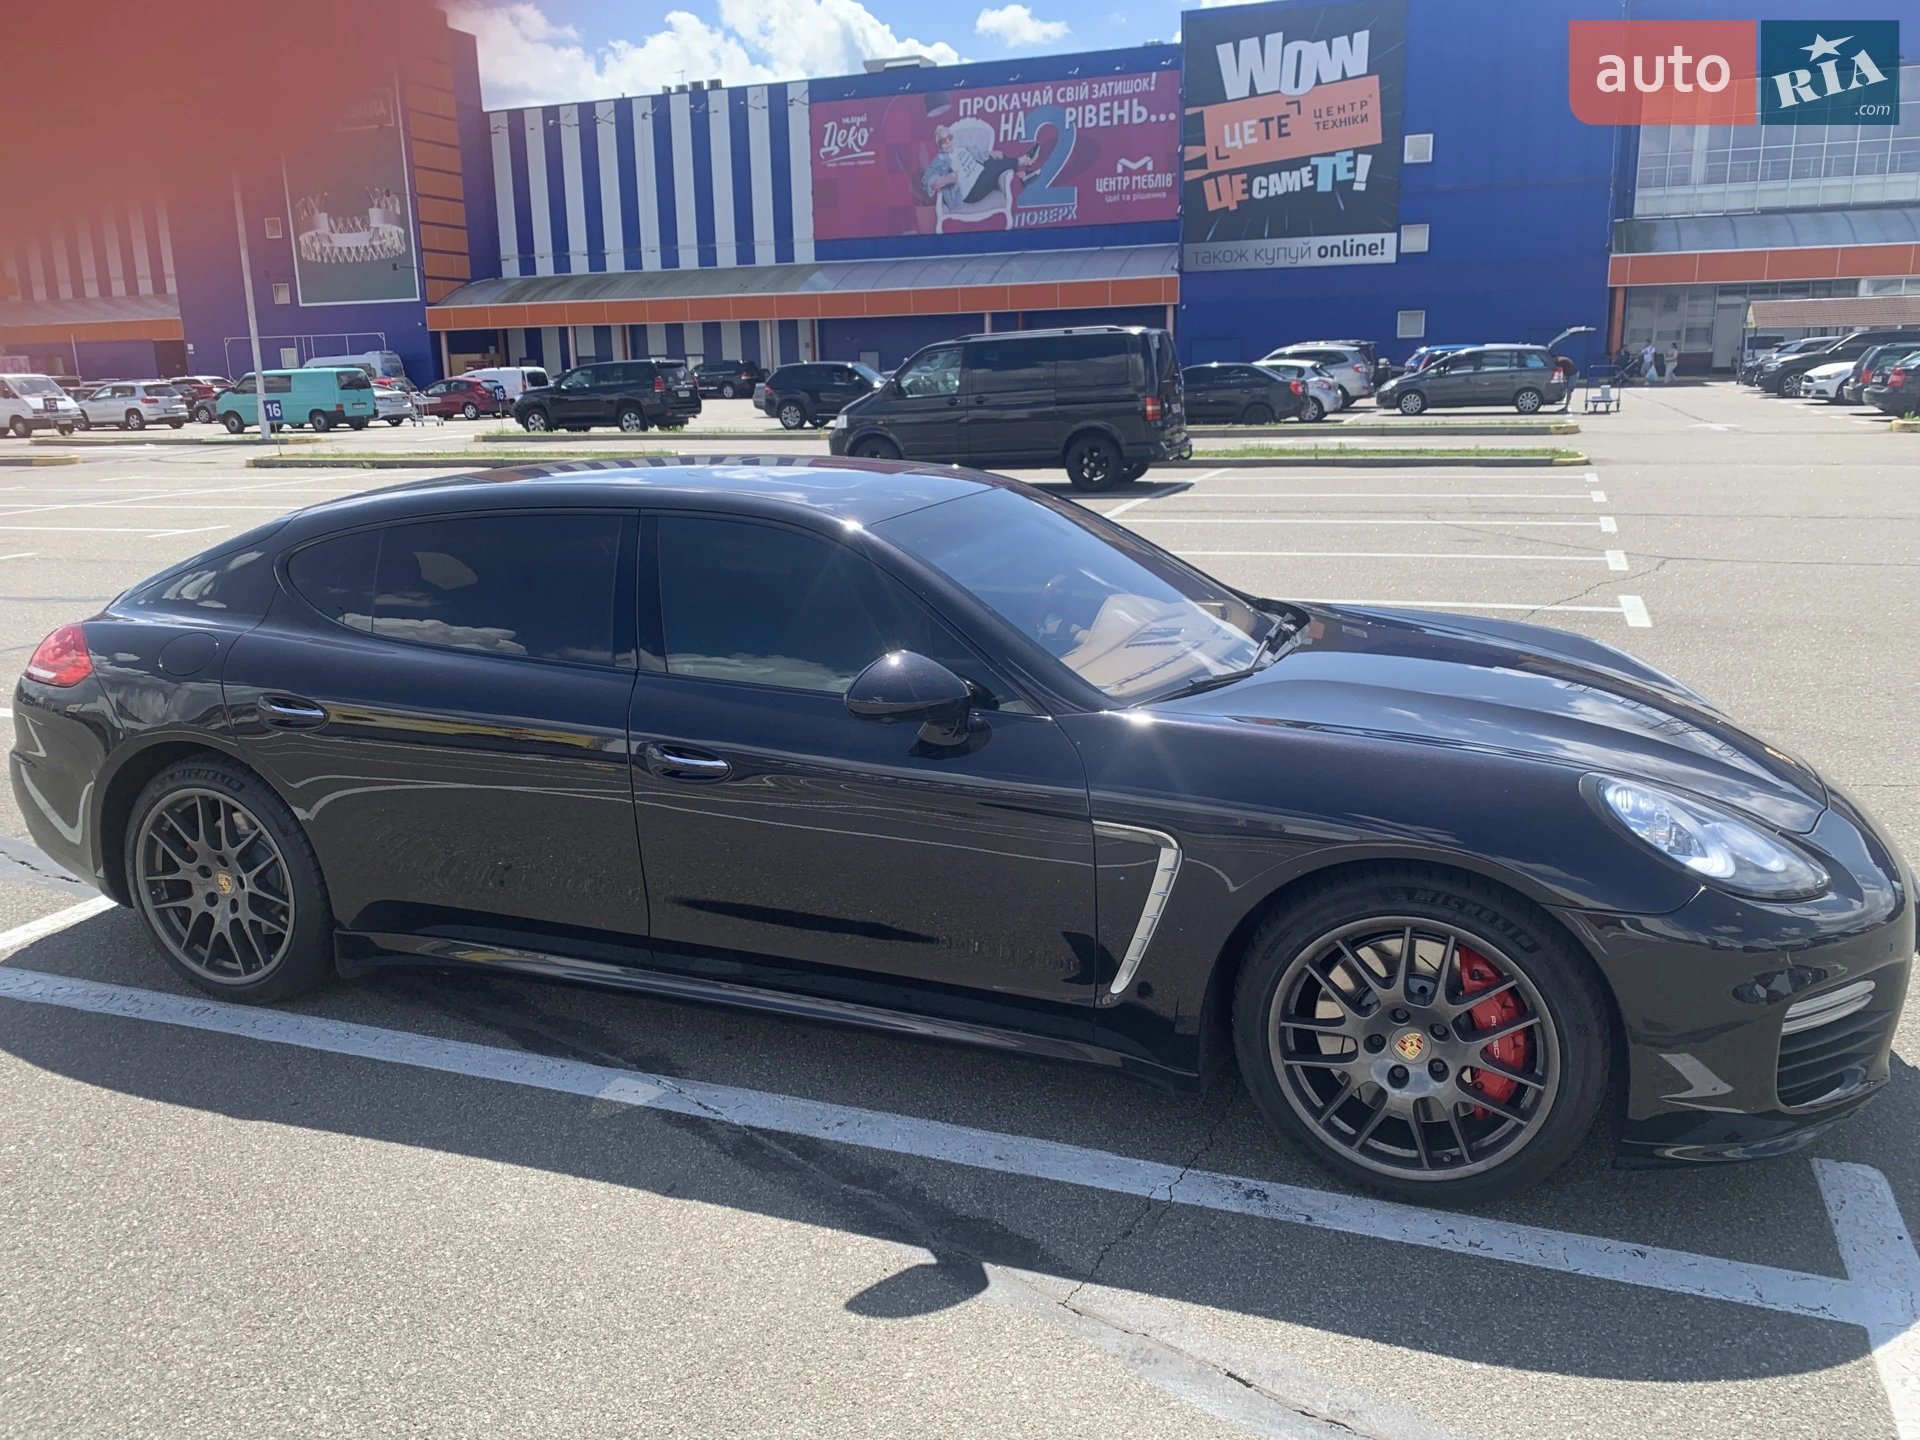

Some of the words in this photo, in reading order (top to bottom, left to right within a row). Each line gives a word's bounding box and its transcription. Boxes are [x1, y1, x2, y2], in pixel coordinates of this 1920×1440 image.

[1215, 29, 1370, 101] WOW
[959, 86, 1053, 117] ПРОКАЧАЙ
[1056, 82, 1089, 104] СВІЙ
[1091, 72, 1157, 99] ЗАТИШОК!
[1313, 100, 1368, 119] ЦЕНТР
[1223, 113, 1292, 149] ЦЕТЕ
[1314, 113, 1369, 131] ТЕХНІКИ
[999, 111, 1027, 142] НА
[1017, 104, 1078, 209] 2
[1096, 176, 1130, 193] ЦЕНТР
[1202, 173, 1250, 212] ЦЕ
[1014, 204, 1078, 228] ПОВЕРХ
[1192, 245, 1249, 265] також
[1254, 241, 1312, 266] купуй
[1317, 238, 1386, 260] online!
[266, 403, 281, 417] 16
[1413, 889, 1542, 954] MICHELIN
